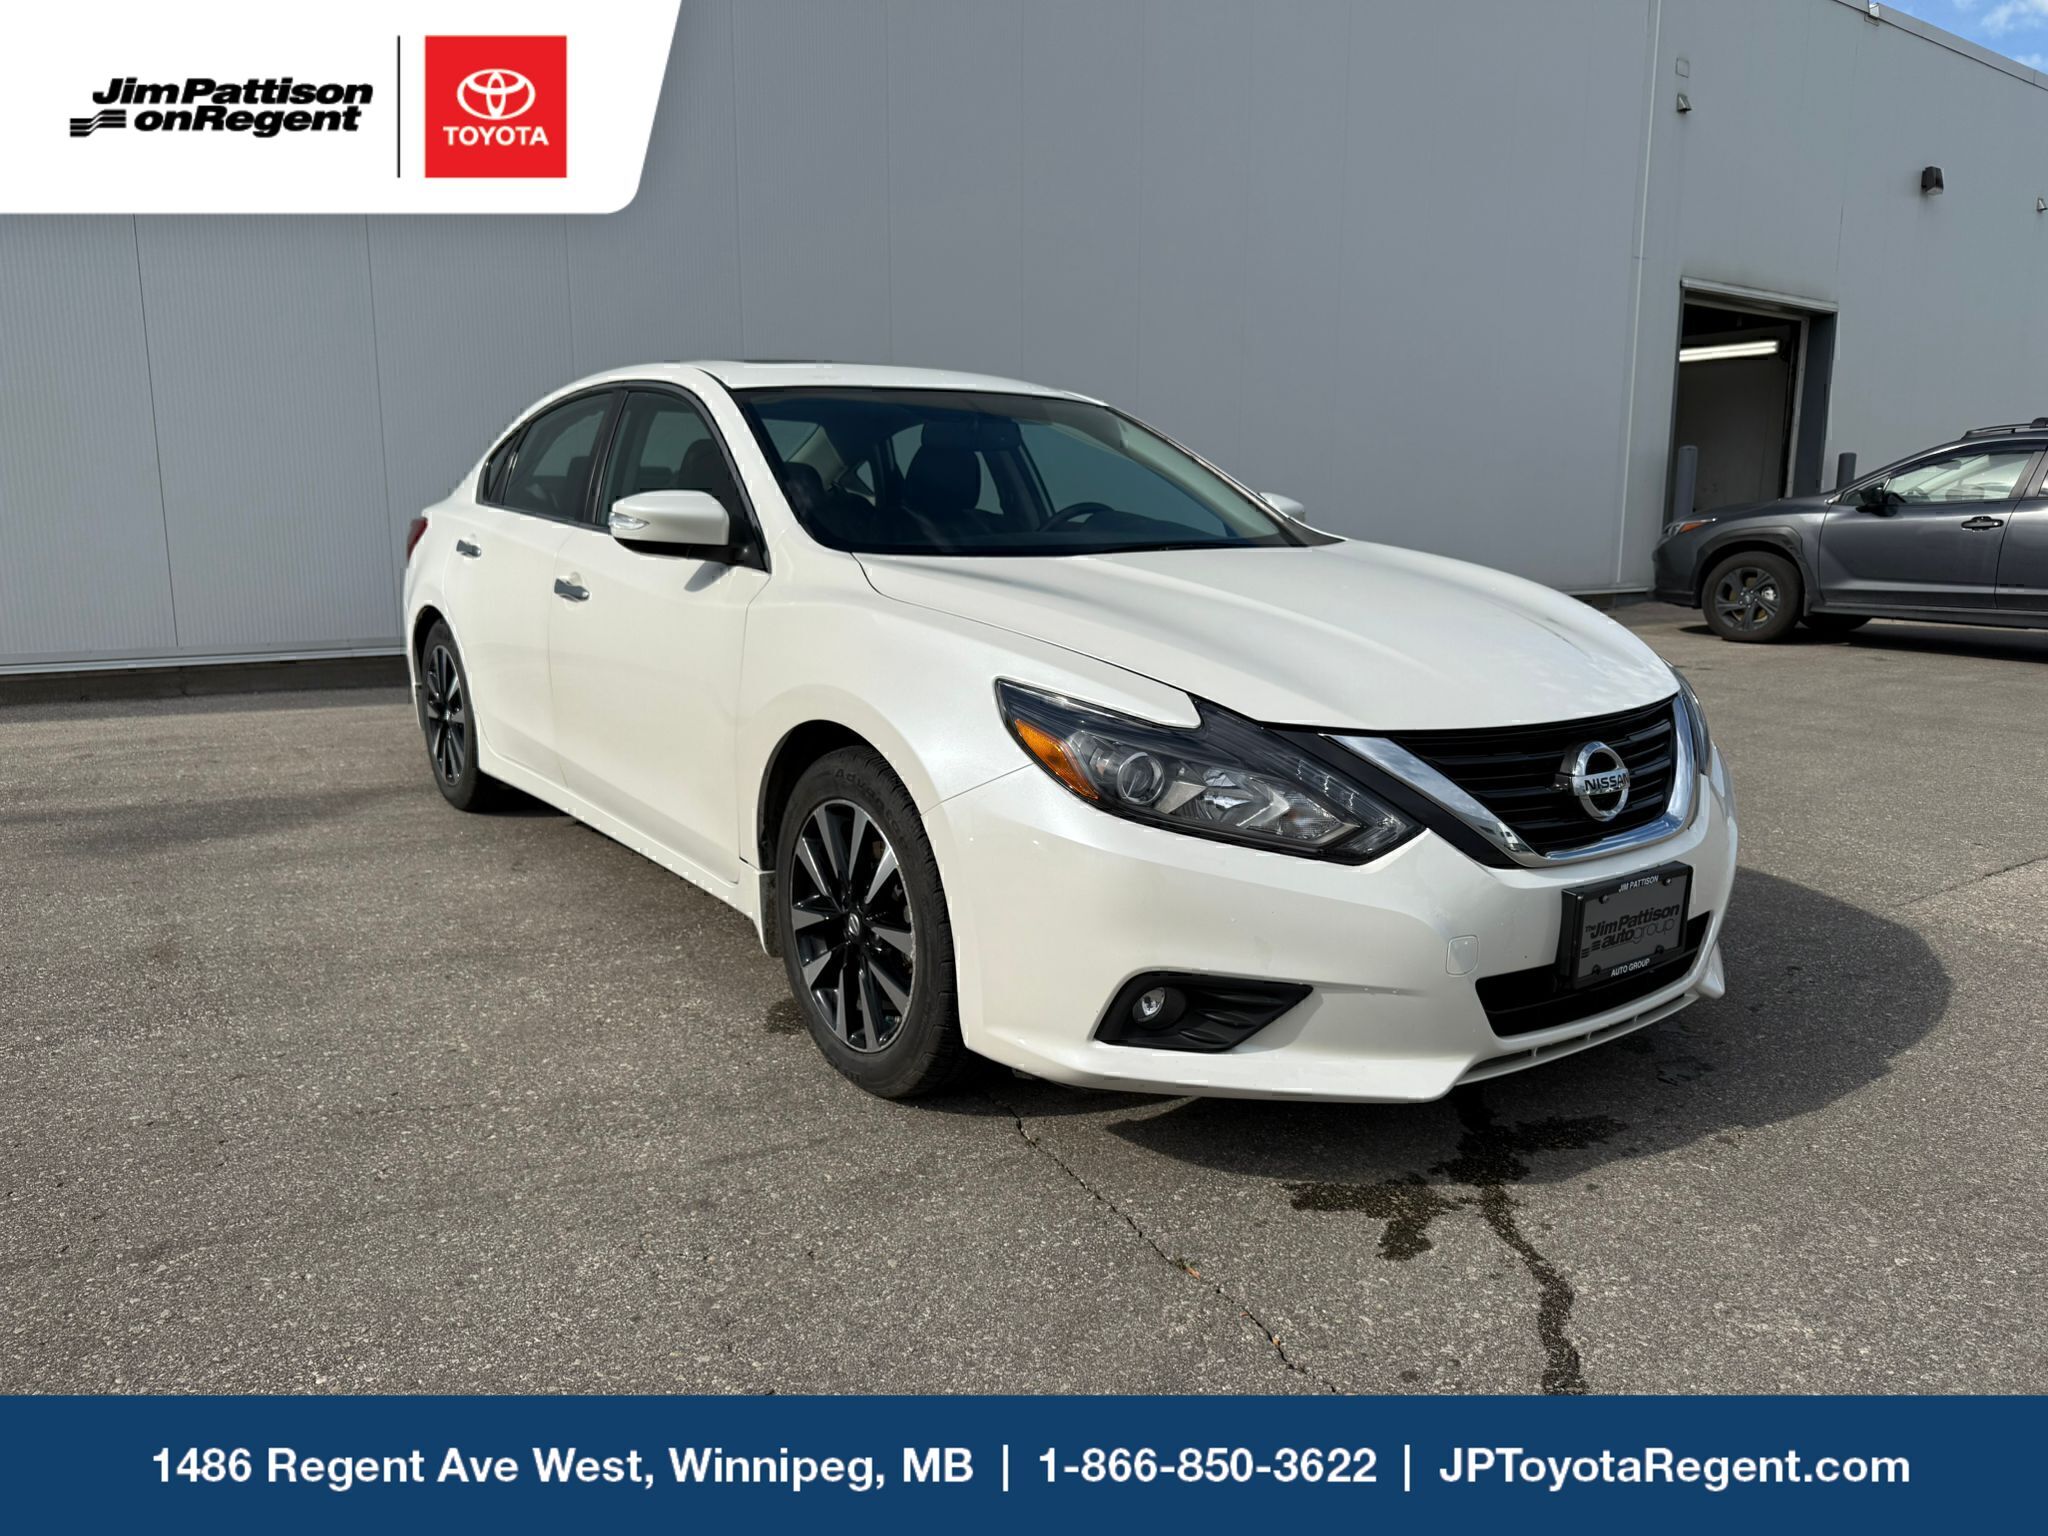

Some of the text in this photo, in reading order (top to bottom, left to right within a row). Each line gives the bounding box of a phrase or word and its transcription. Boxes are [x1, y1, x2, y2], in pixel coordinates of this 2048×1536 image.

[1584, 772, 1629, 791] NISSAN
[1618, 875, 1659, 893] JIM PATTISON
[1611, 958, 1651, 977] AUTO GROUP
